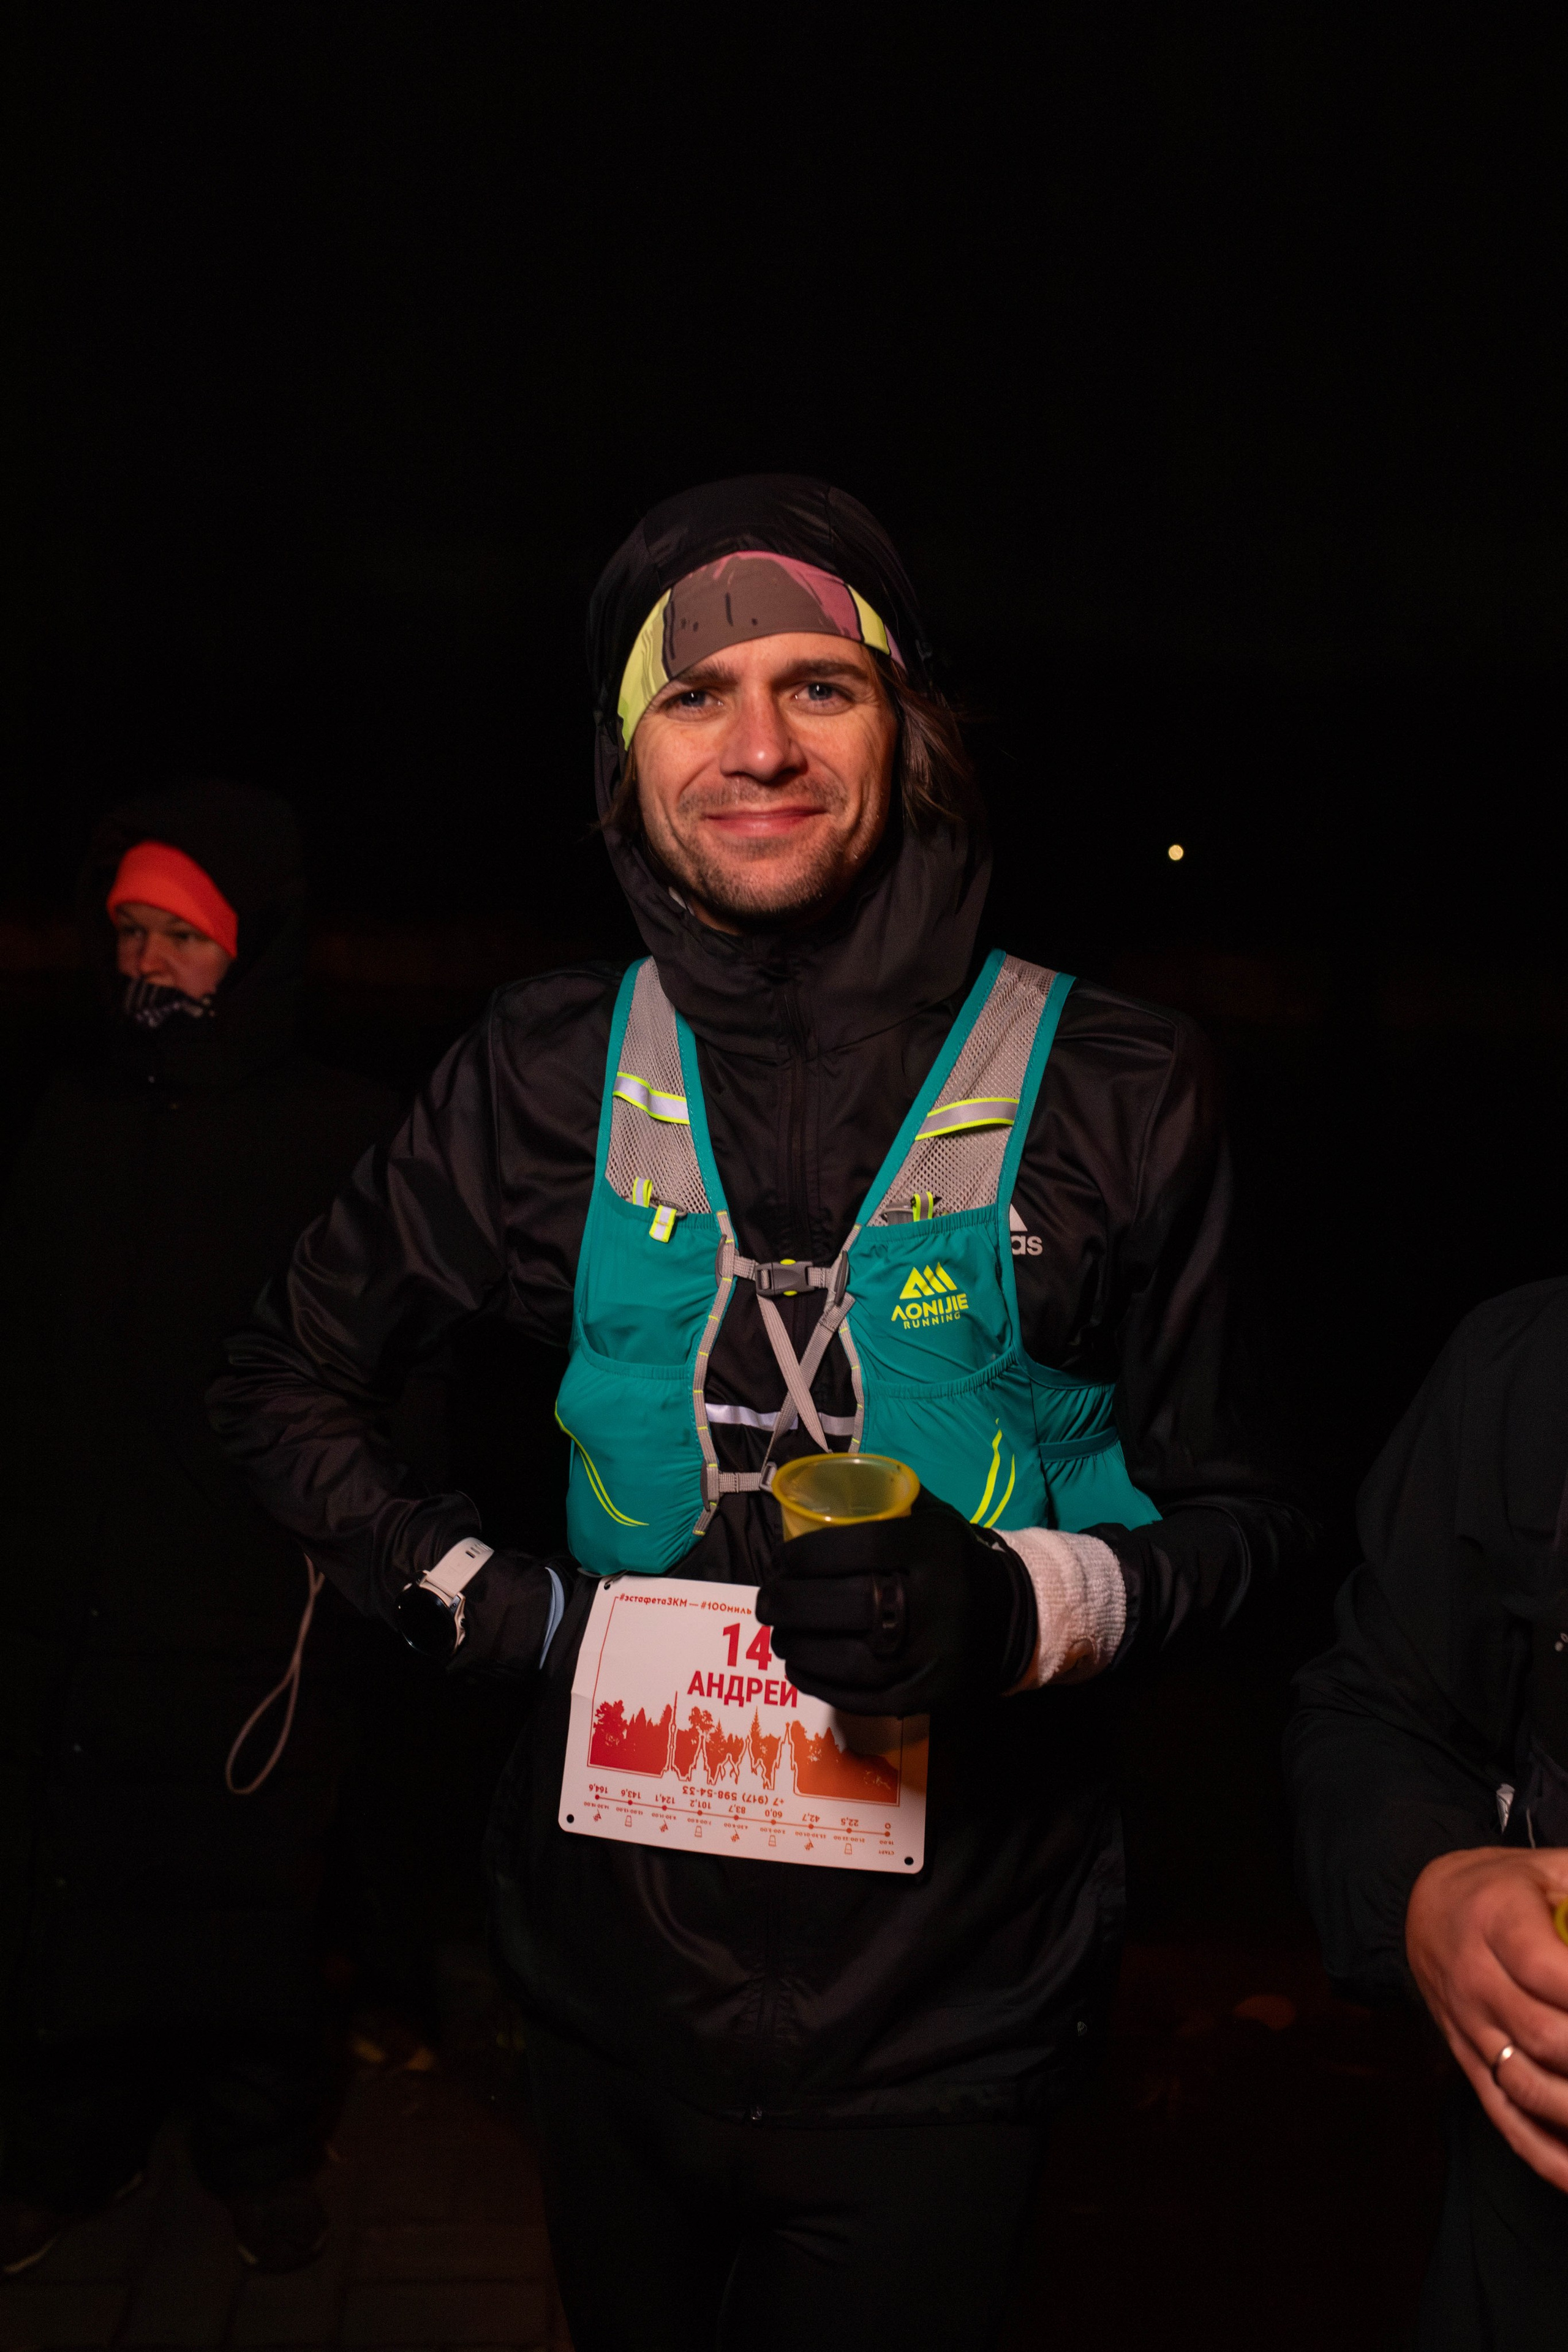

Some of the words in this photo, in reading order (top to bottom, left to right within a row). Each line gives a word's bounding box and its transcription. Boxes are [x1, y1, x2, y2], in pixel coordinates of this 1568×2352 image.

[891, 1292, 970, 1322] AONIJIE
[903, 1311, 961, 1330] RUNNING
[723, 1623, 772, 1671] 14
[687, 1670, 798, 1708] АНДРЕЙ
[589, 1783, 608, 1794] 164,6
[682, 1785, 737, 1801] 598-54-33
[621, 1789, 641, 1800] 143,6
[655, 1793, 675, 1804] 124,1
[742, 1792, 769, 1805] (917)
[690, 1798, 711, 1809] 101,2
[729, 1804, 746, 1814] 83,7
[765, 1809, 783, 1818] 60,0
[802, 1812, 820, 1823] 42,7
[841, 1817, 859, 1826] 22,5
